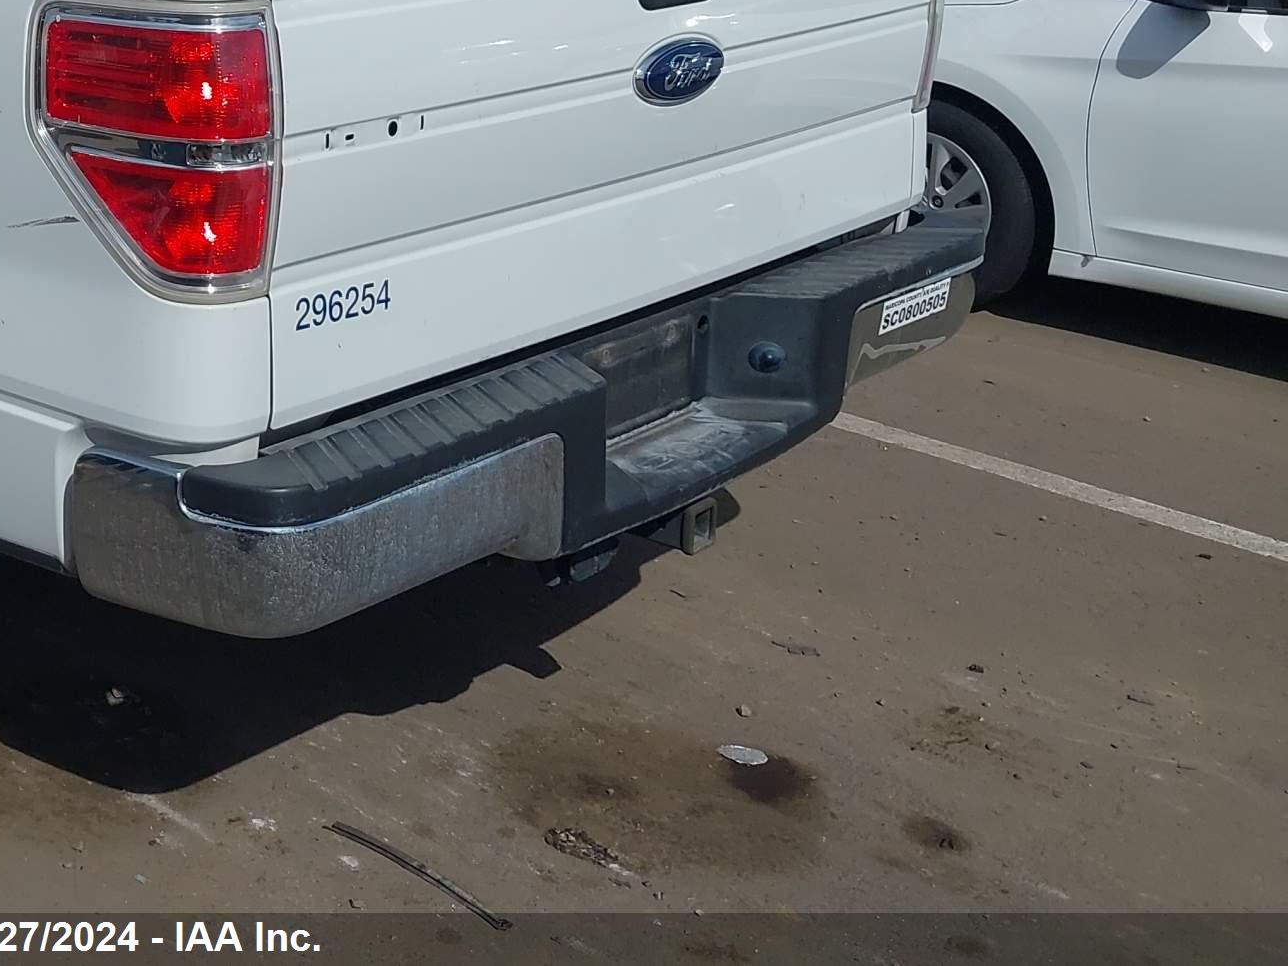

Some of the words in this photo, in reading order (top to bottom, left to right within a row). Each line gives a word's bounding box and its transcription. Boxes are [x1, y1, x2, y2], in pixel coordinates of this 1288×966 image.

[664, 52, 713, 91] Ford
[295, 279, 391, 331] 296254
[882, 291, 947, 331] SC0800505
